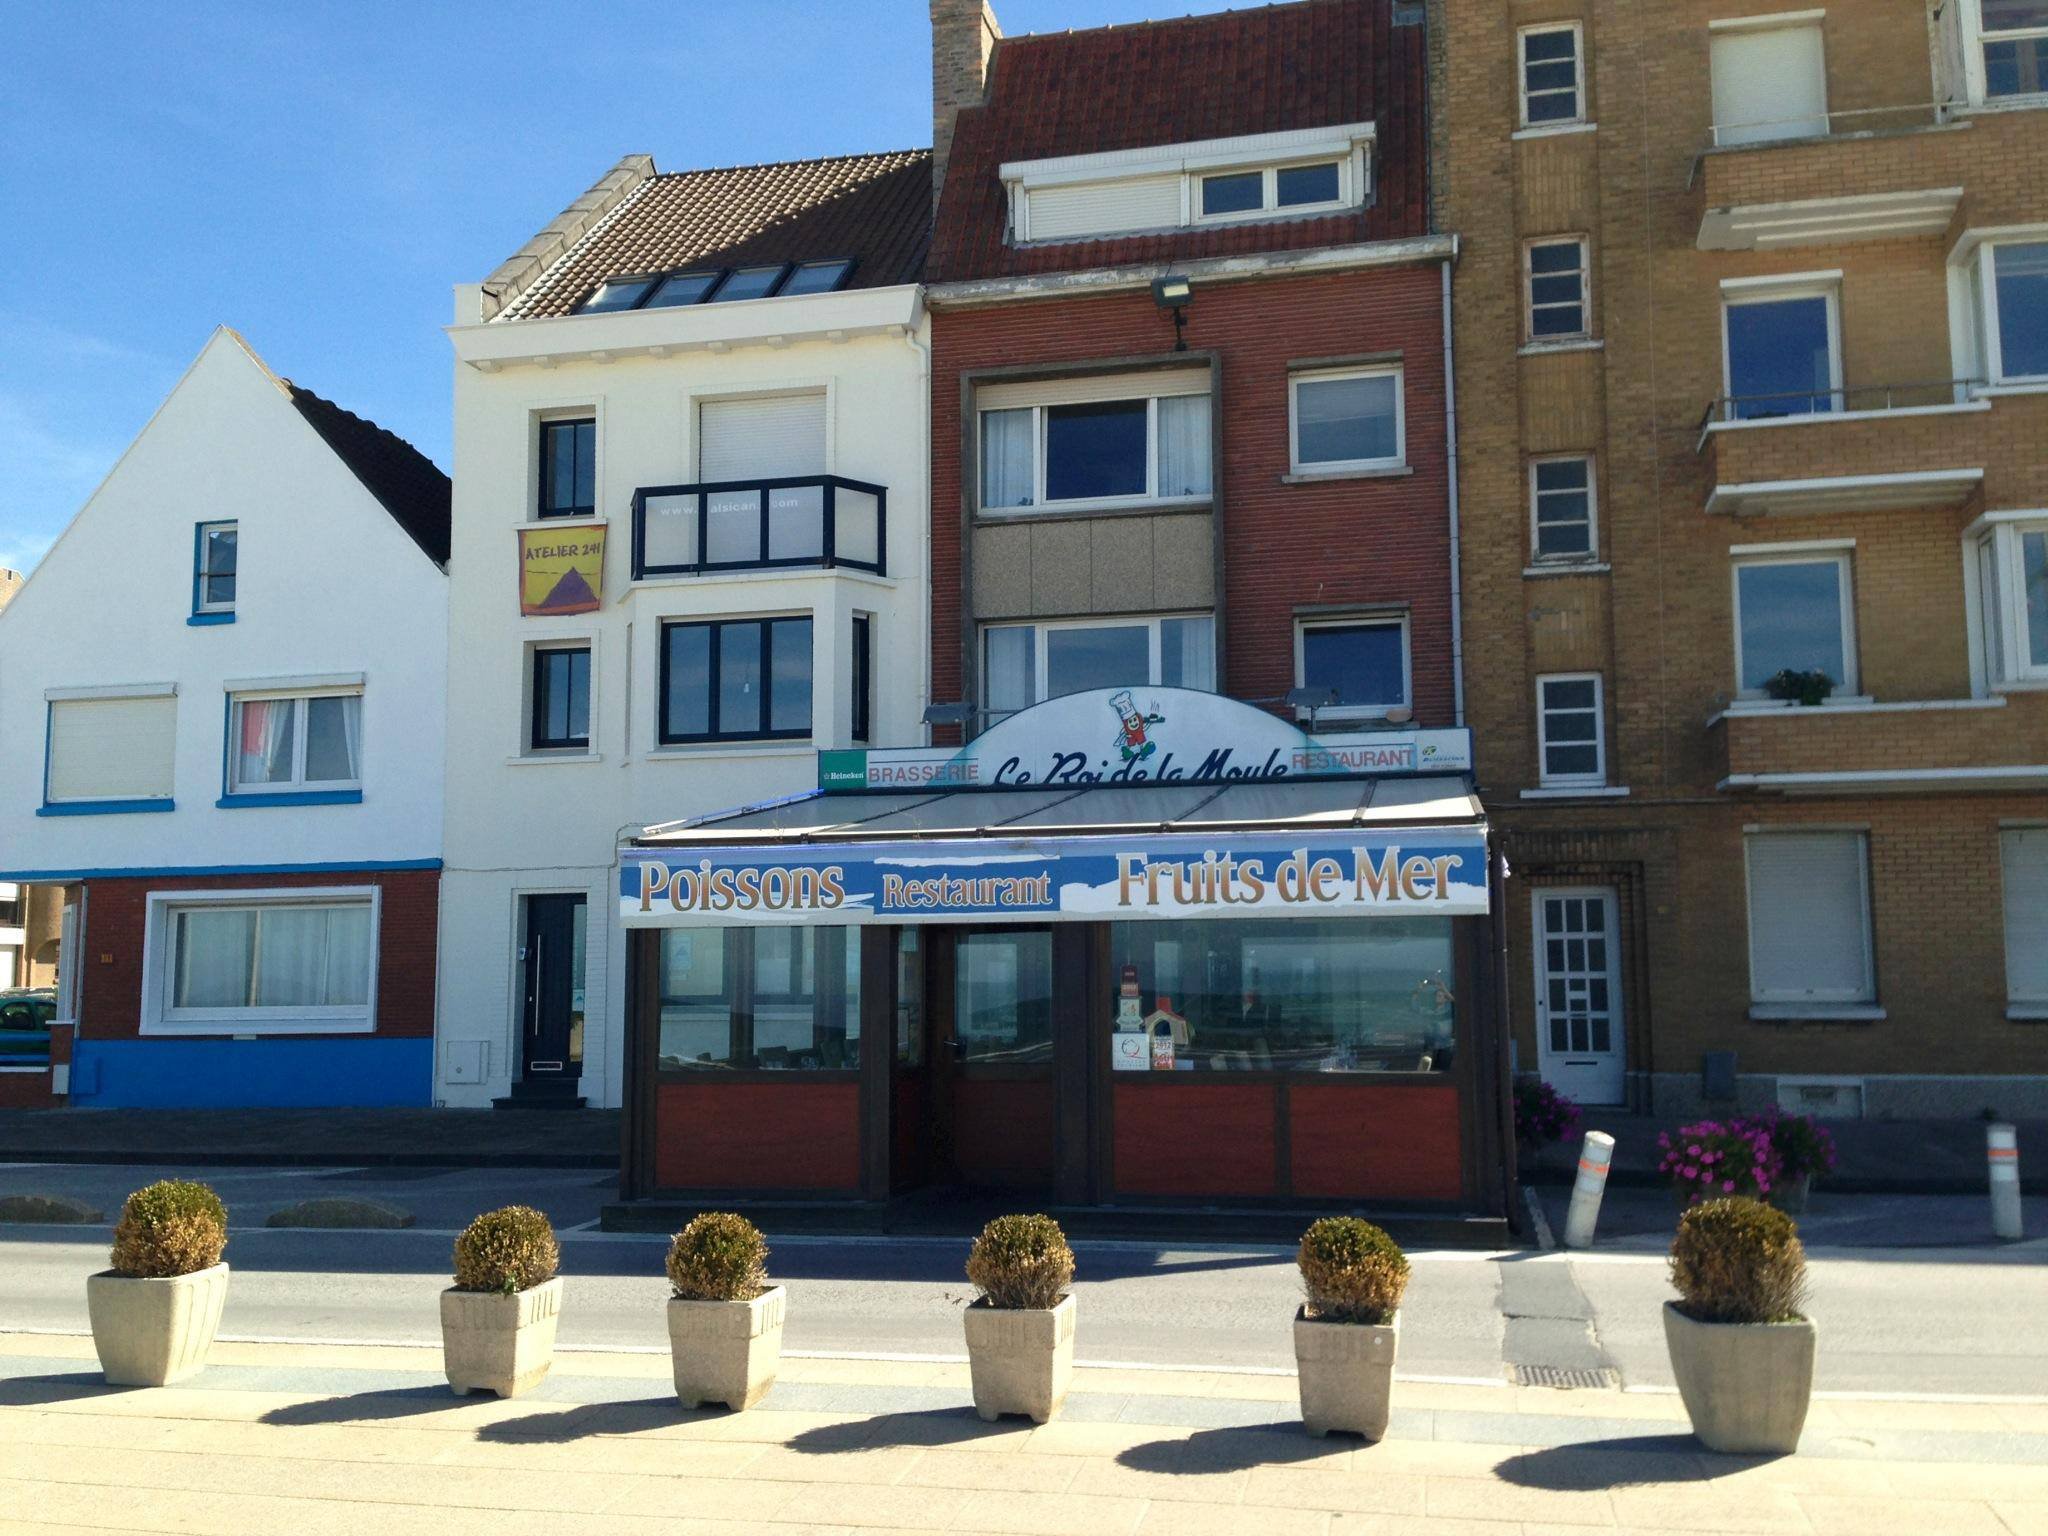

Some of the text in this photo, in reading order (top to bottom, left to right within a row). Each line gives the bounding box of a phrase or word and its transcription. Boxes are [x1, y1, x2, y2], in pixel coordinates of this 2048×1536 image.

[525, 544, 579, 560] ATELIER
[1043, 751, 1109, 785] Roi
[1110, 752, 1148, 783] de
[1156, 752, 1184, 782] la
[1190, 748, 1289, 781] Moule
[1292, 749, 1415, 769] RESTAURANT
[830, 771, 864, 780] Heineken
[868, 764, 979, 783] BRASSERIE
[637, 857, 846, 913] Poissons
[882, 869, 1054, 909] Restaurant
[1115, 845, 1463, 906] Fruits de Mer
